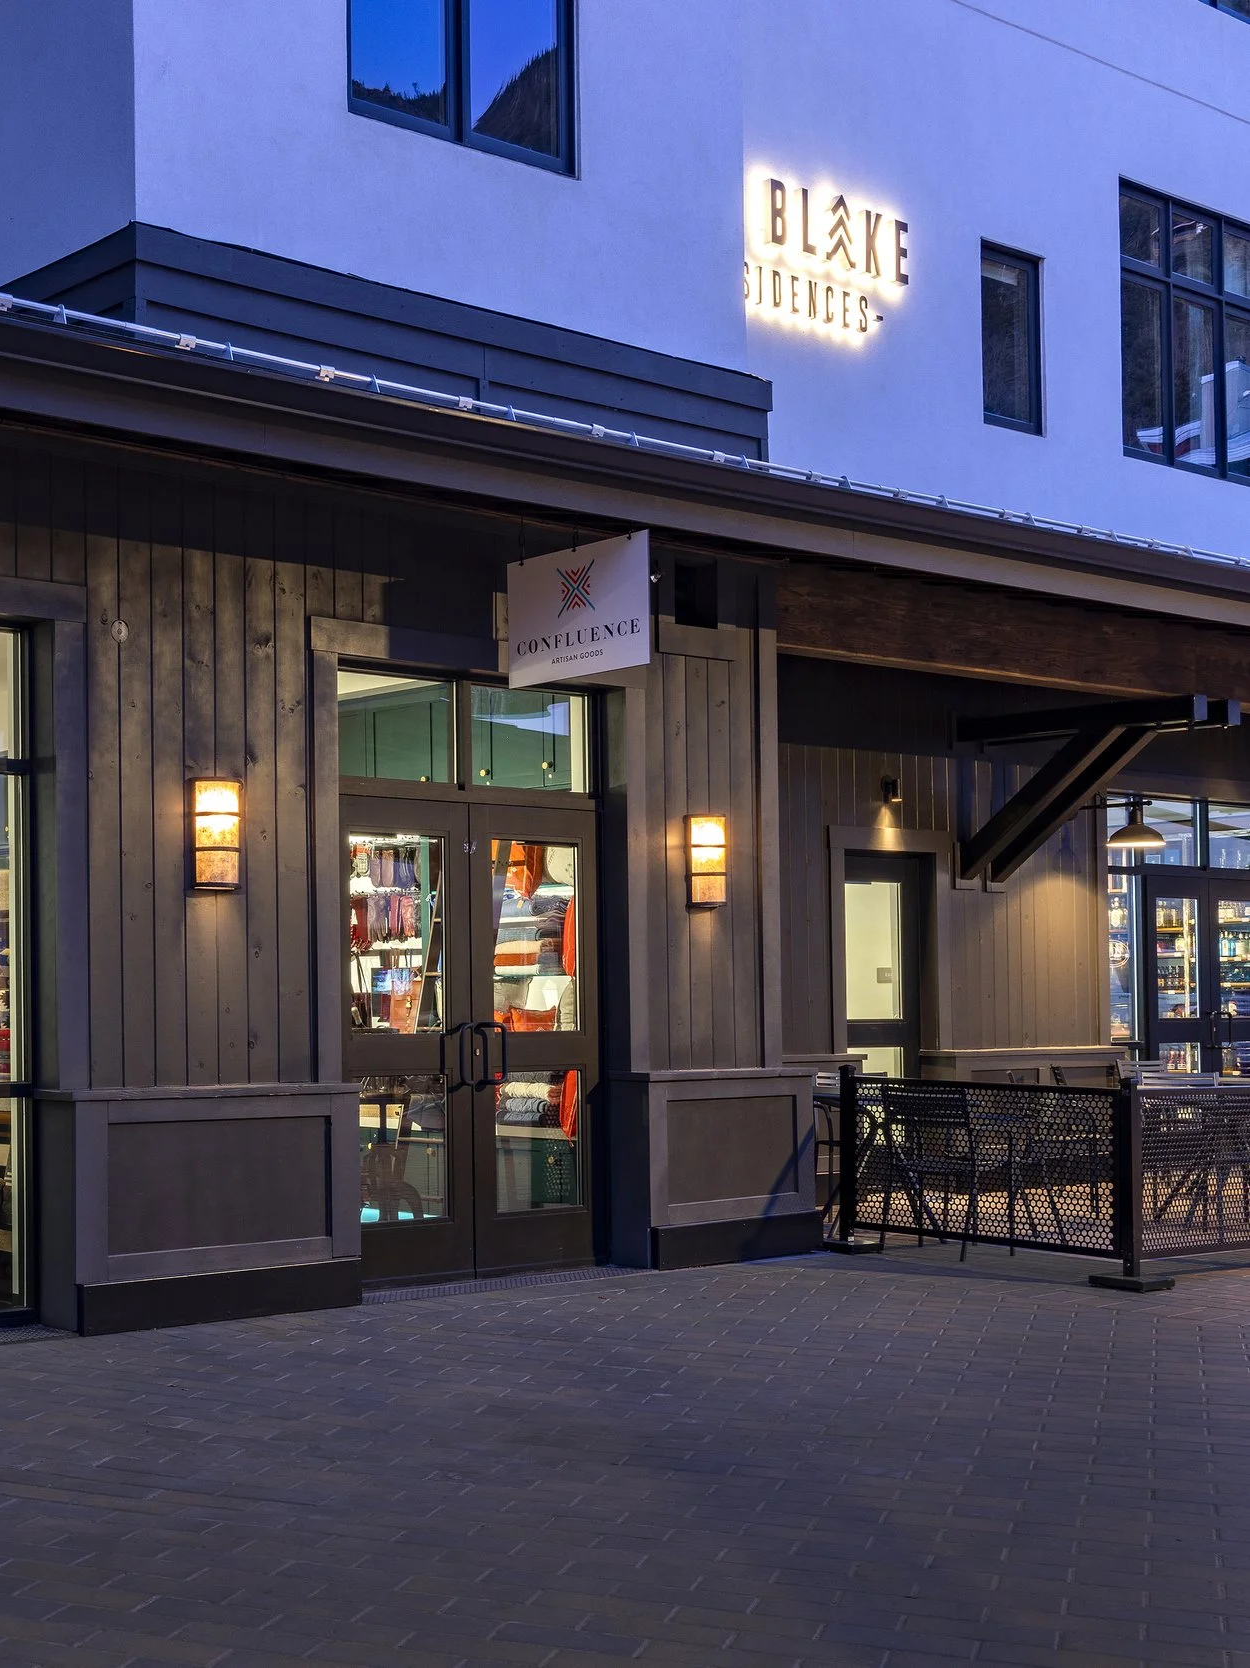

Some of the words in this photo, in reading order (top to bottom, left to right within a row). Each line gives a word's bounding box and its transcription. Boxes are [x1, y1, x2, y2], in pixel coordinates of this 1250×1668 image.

[516, 618, 641, 656] CONFLUENCE
[551, 653, 578, 665] ARTISAN
[579, 648, 604, 660] GOODS
